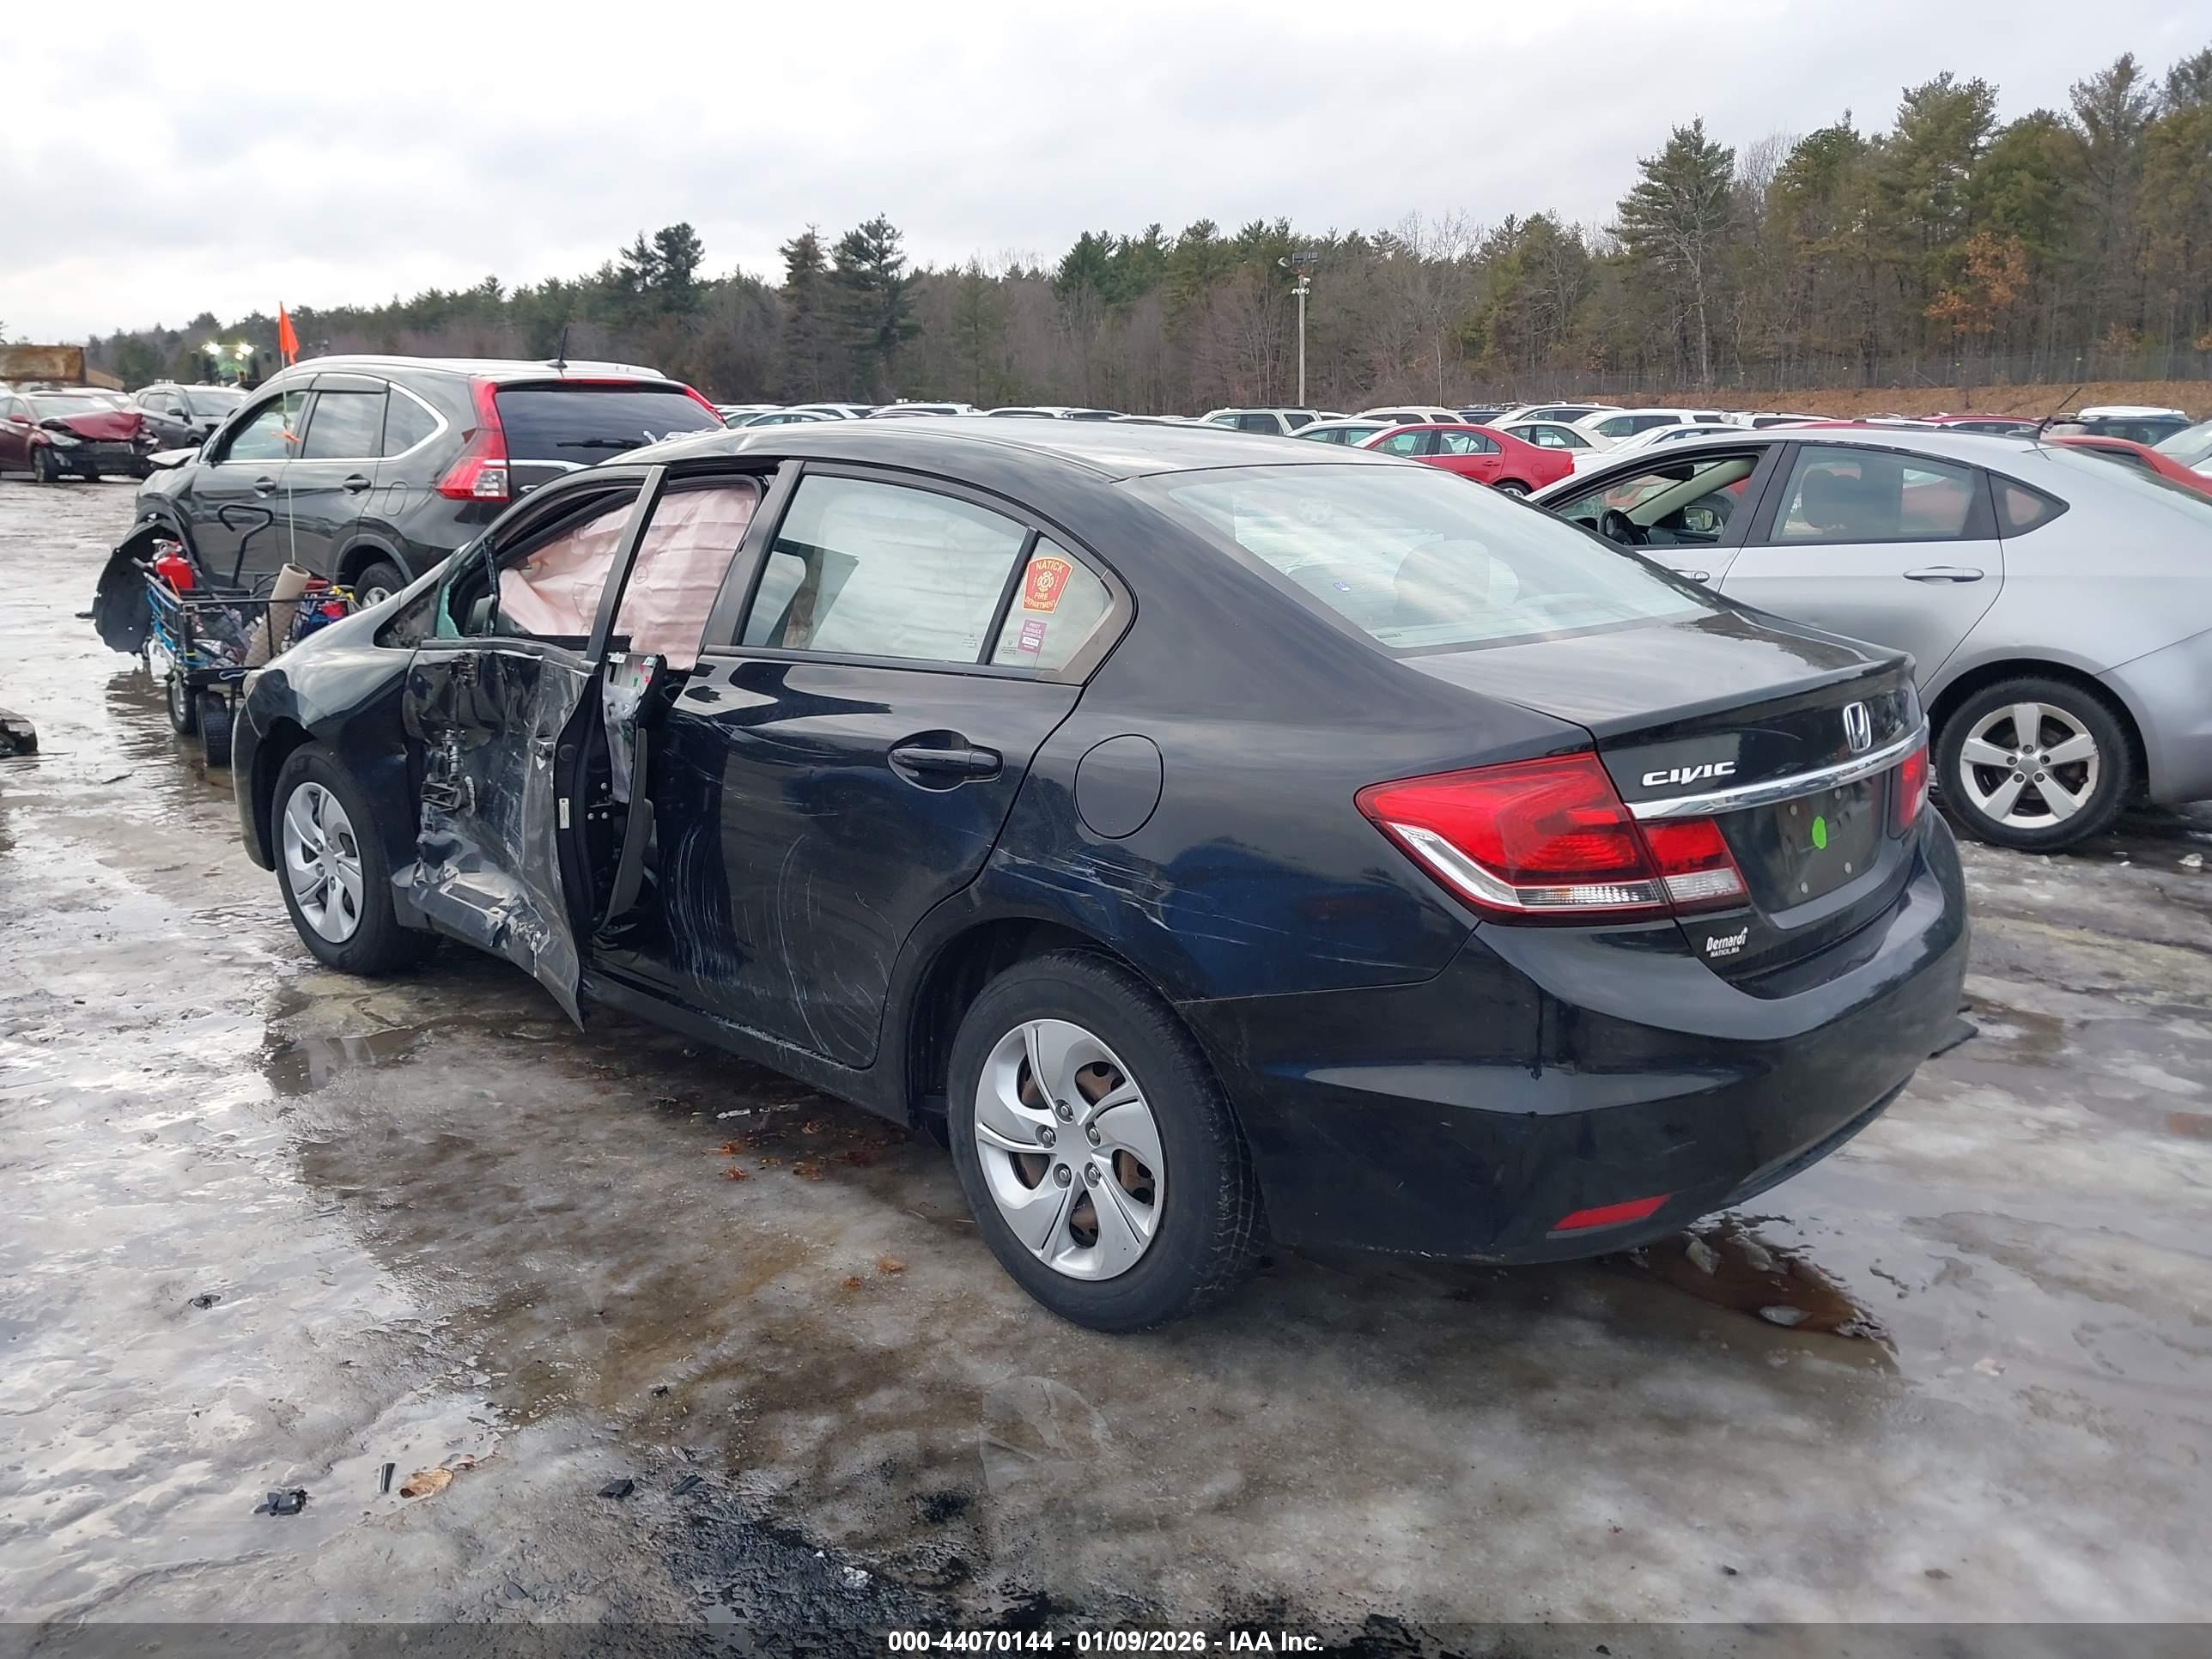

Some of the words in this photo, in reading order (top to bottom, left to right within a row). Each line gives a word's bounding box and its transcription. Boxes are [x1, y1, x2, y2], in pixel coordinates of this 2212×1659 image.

[1036, 559, 1065, 574] NATICK
[1024, 596, 1055, 609] DEPARTMENT
[1034, 592, 1049, 600] FIRE
[1642, 761, 1736, 787] CIVIC
[1706, 926, 1748, 952] Bernardi
